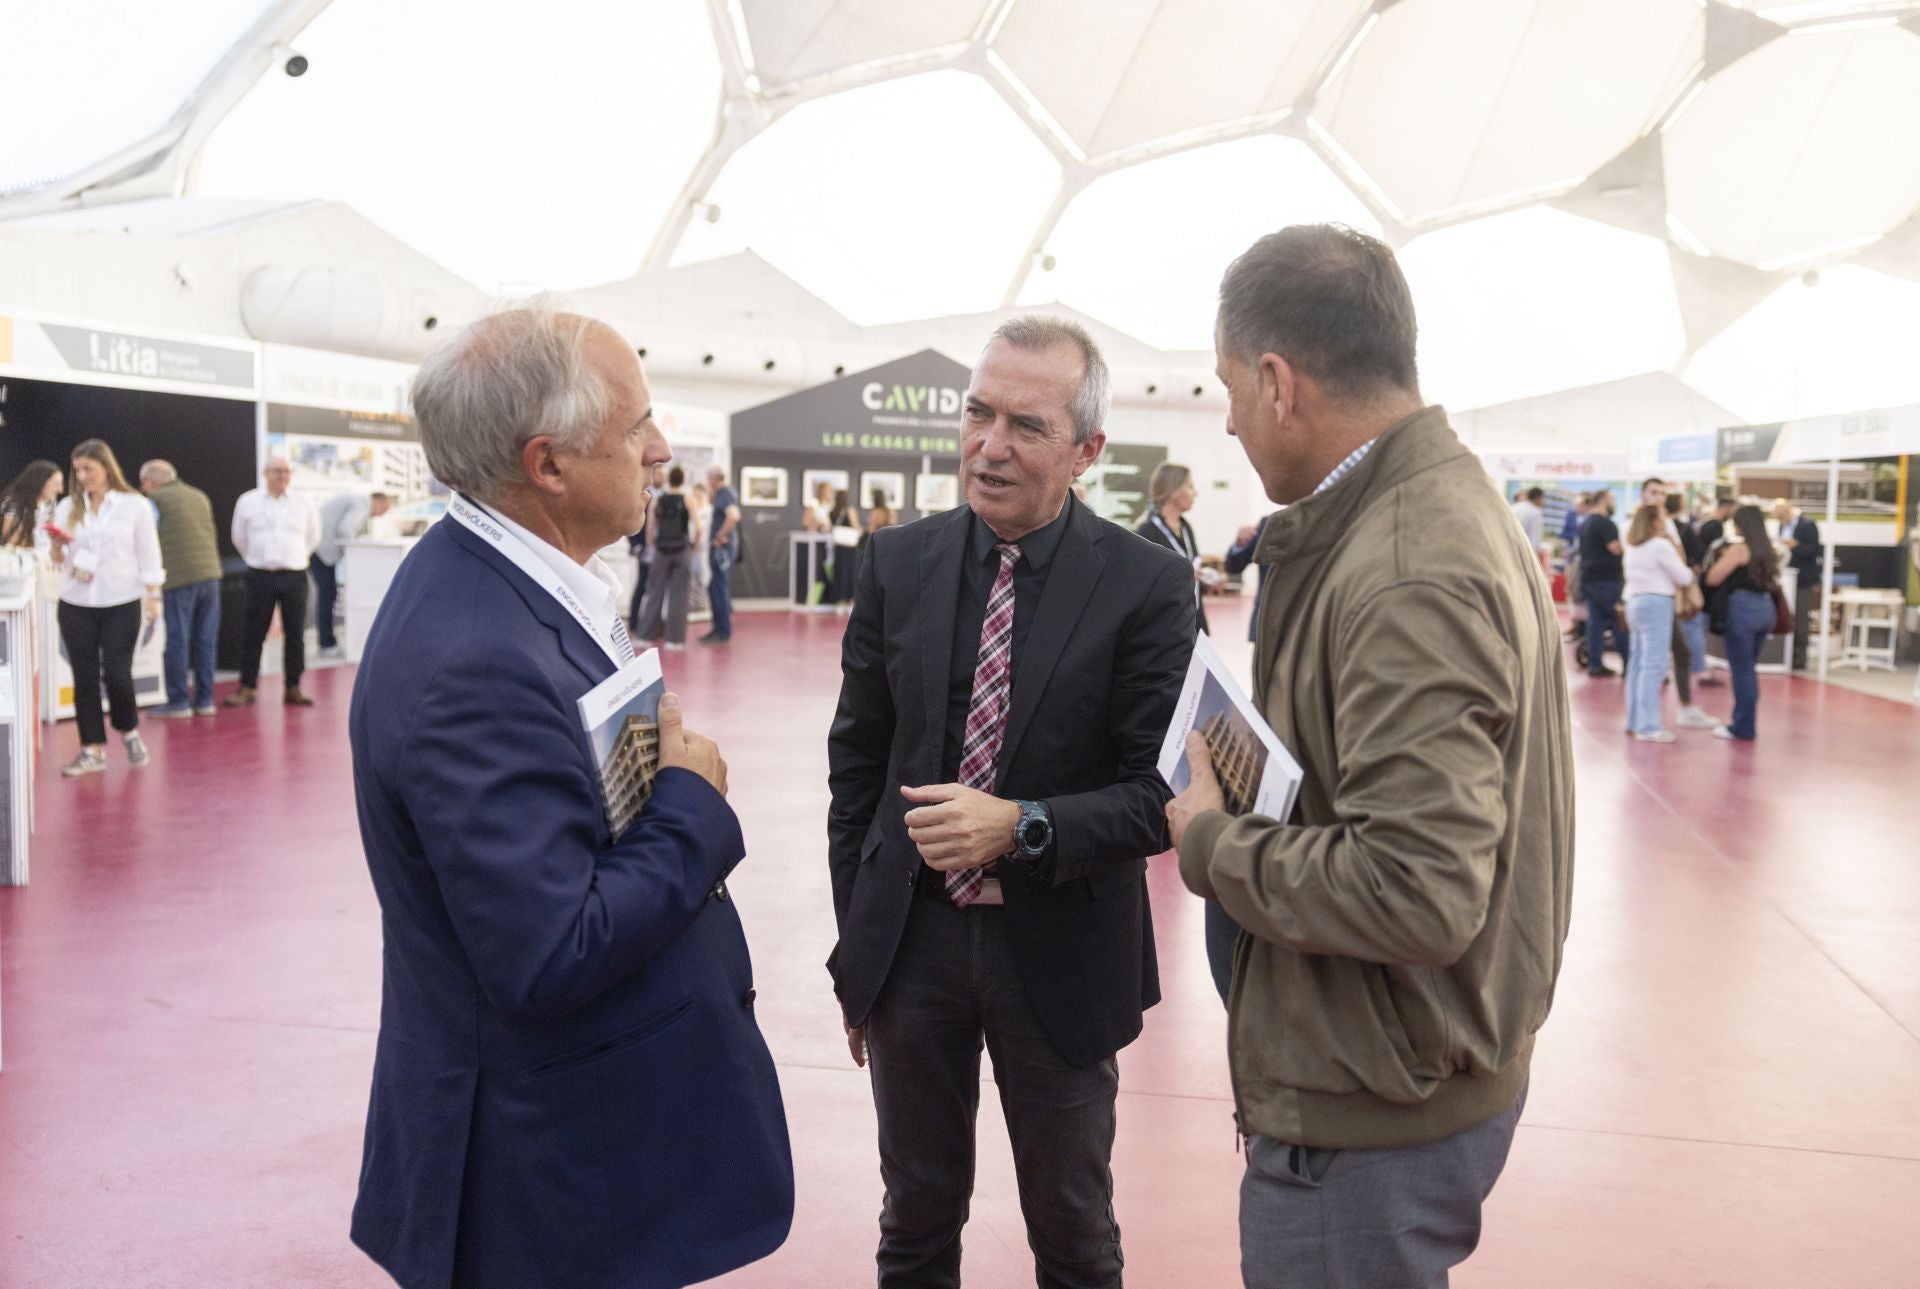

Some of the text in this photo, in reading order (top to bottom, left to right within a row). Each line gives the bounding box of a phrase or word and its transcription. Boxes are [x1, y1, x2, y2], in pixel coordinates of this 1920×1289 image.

[90, 333, 158, 376] Litia
[822, 431, 855, 448] LAS
[860, 433, 914, 451] CASAS
[1535, 459, 1594, 475] metro
